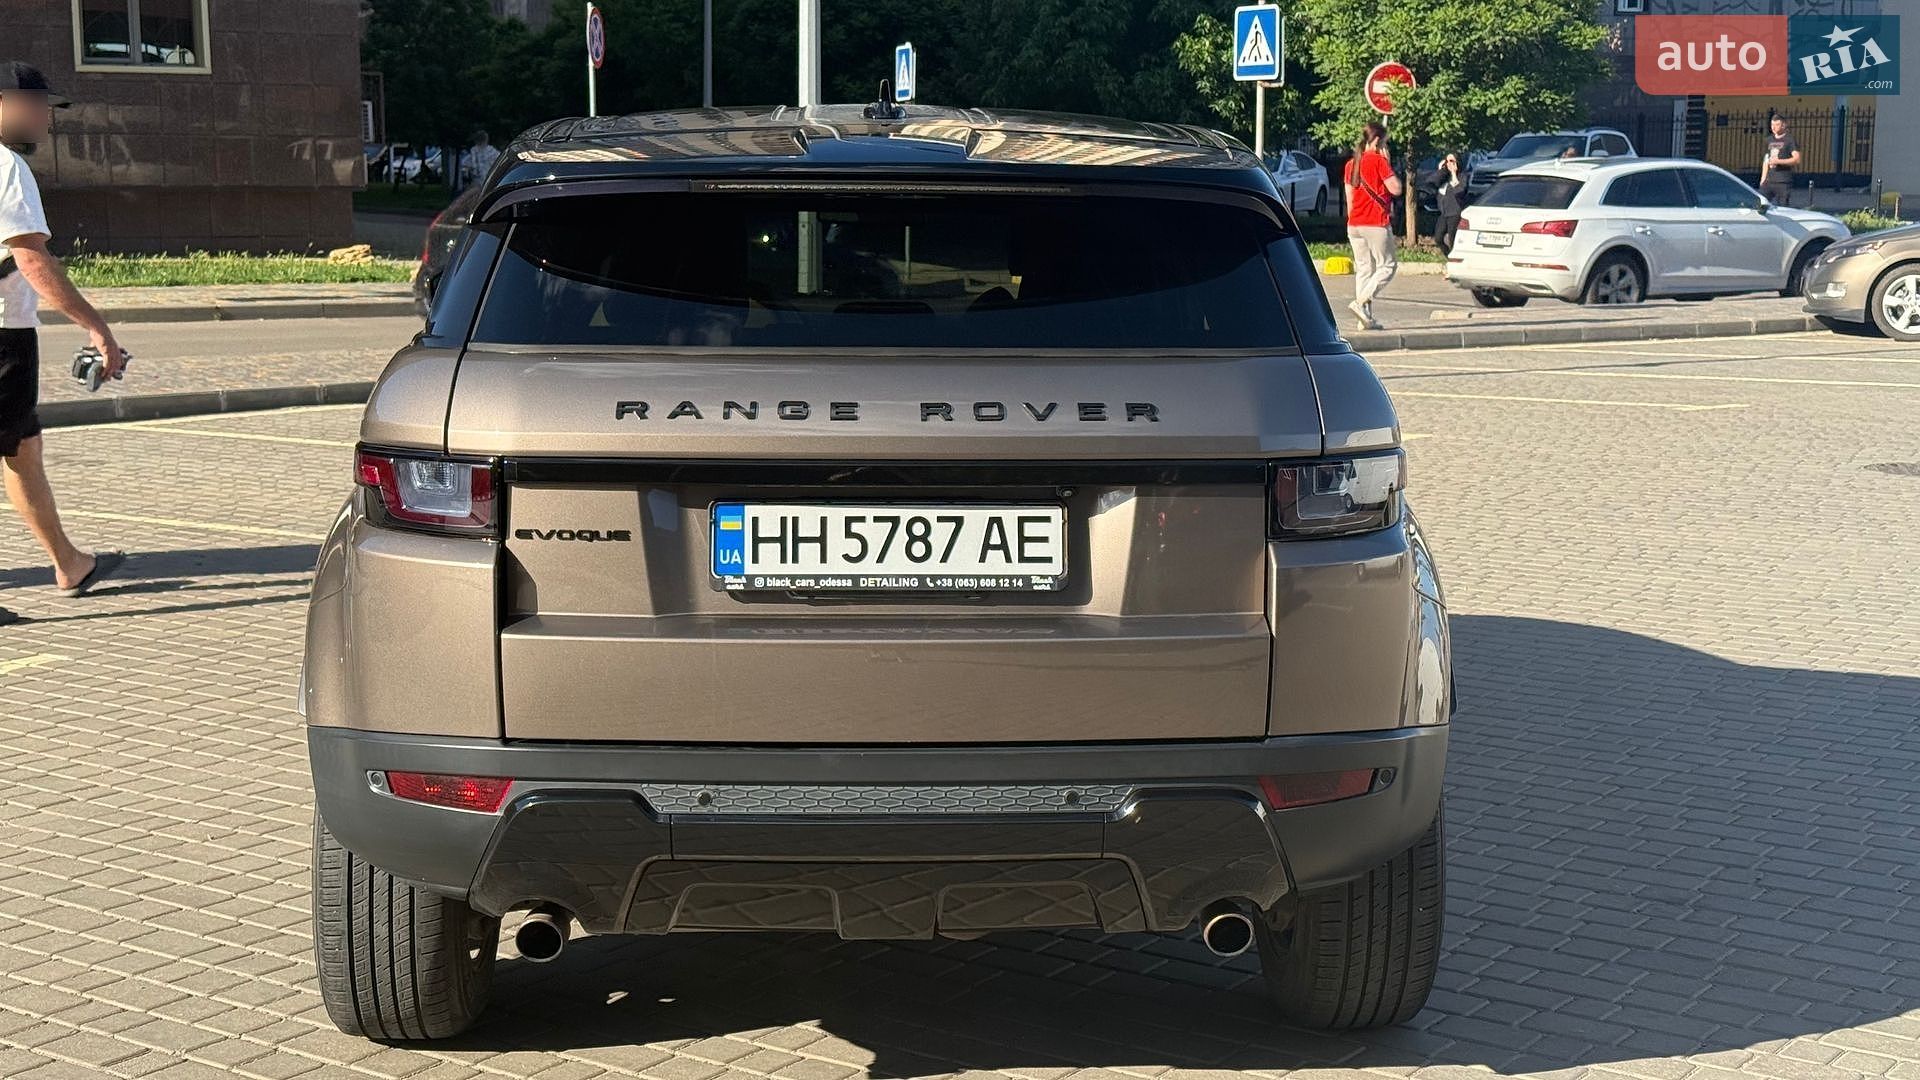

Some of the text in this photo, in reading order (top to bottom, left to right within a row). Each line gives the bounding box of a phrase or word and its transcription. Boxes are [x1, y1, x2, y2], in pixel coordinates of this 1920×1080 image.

[615, 400, 1160, 422] RANGE ROVER
[515, 529, 632, 542] EVOQUE
[751, 516, 1054, 564] HH 5787 AE
[719, 549, 742, 565] UA
[766, 577, 1024, 589] black_cars_odessa DETAILING +38 (063) 608 12 14
